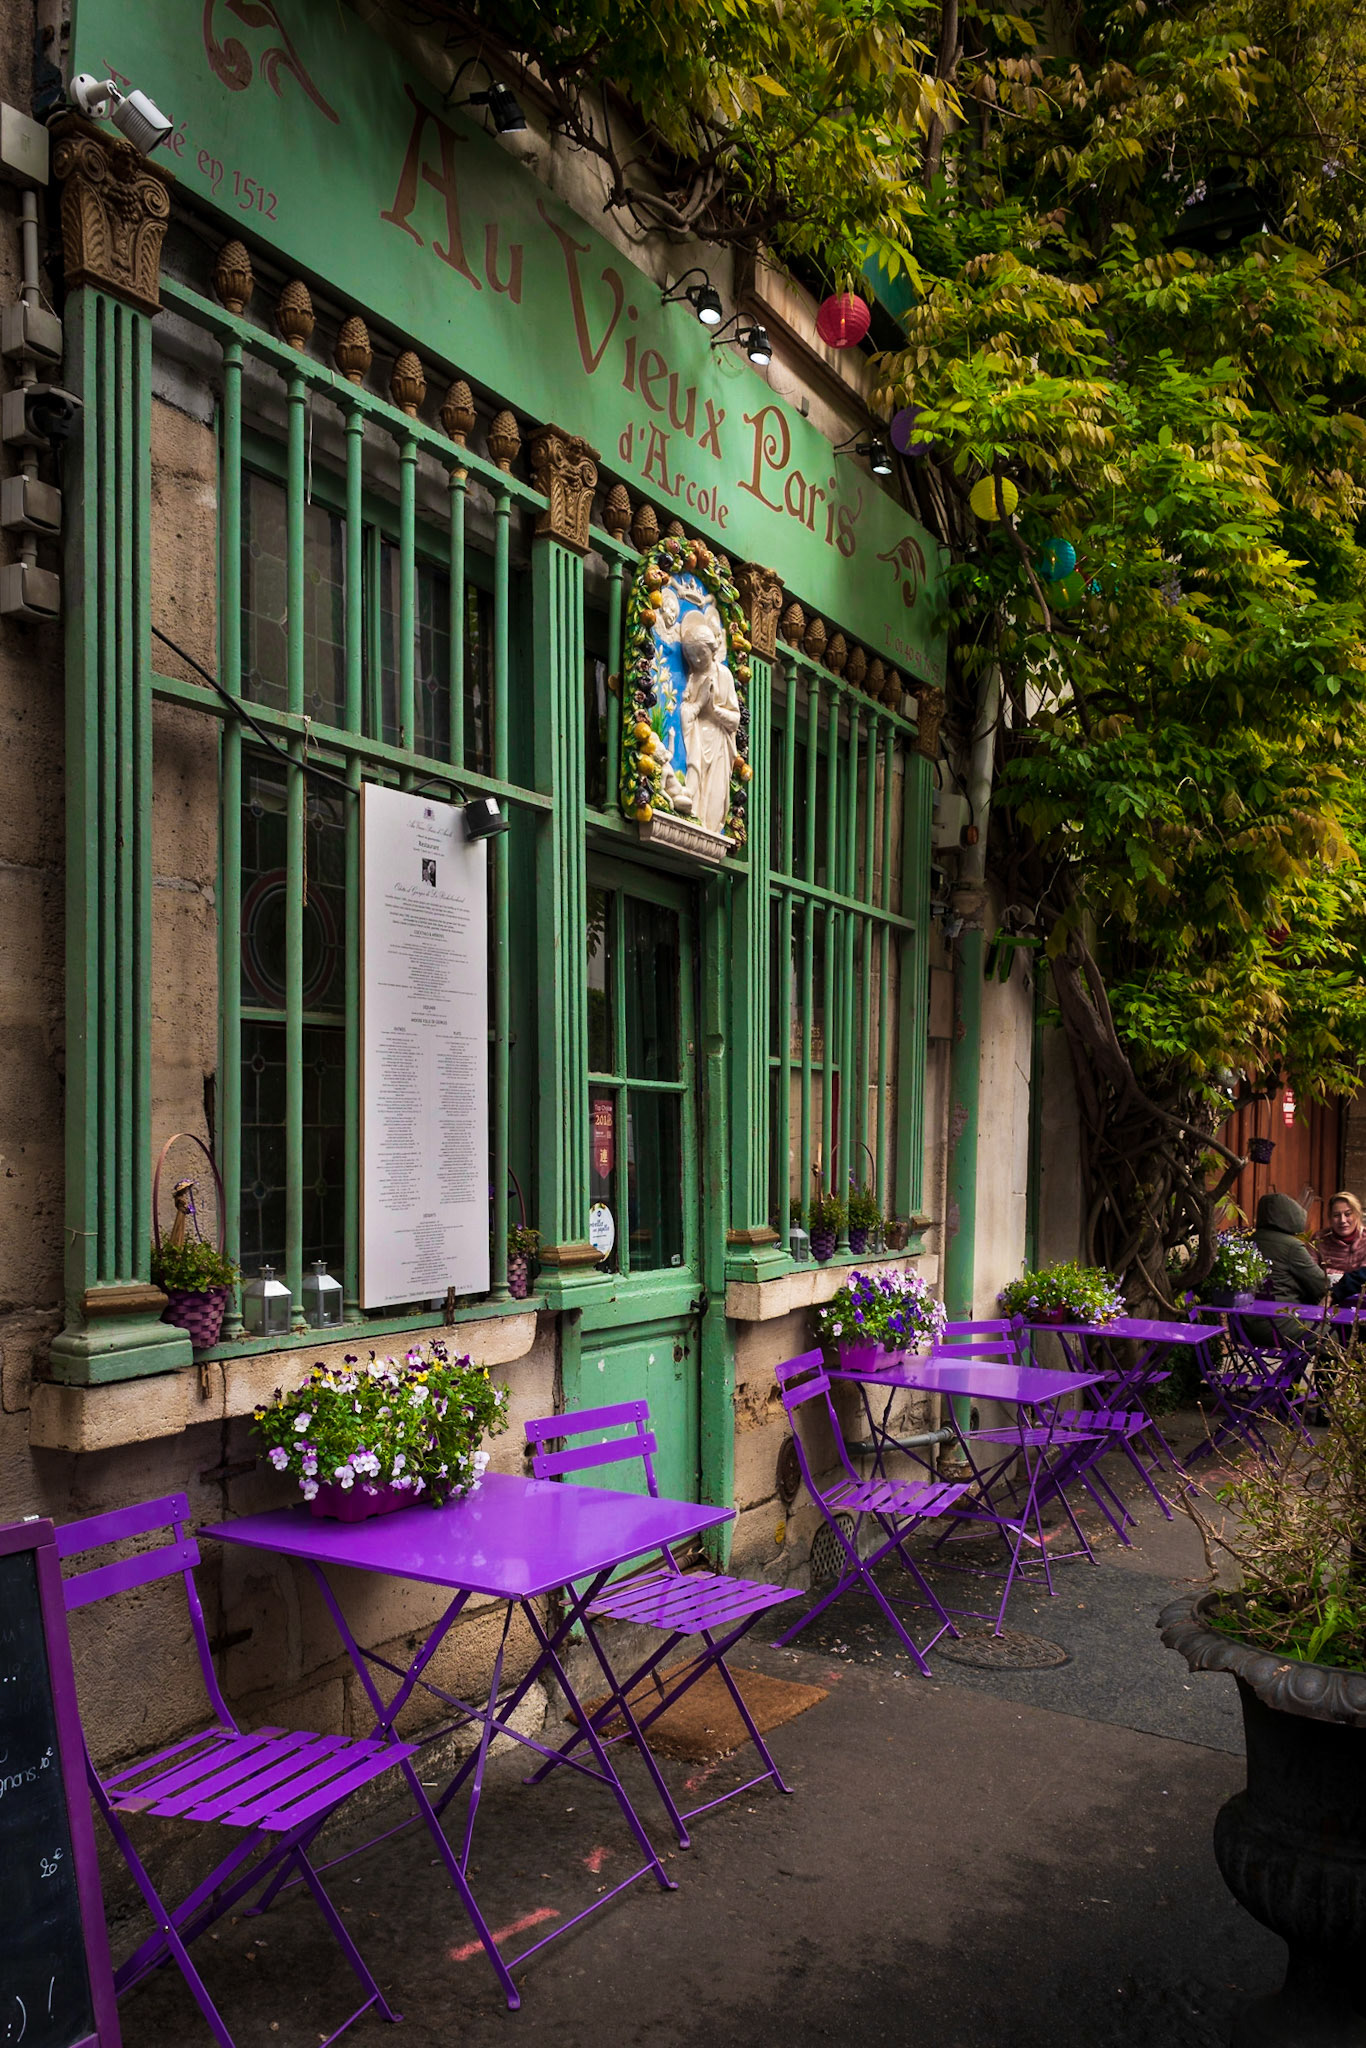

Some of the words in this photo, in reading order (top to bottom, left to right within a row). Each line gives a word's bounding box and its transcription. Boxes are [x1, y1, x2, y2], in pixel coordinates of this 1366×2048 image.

[197, 148, 224, 196] en
[232, 170, 278, 222] 1512
[380, 83, 523, 306] Au
[536, 197, 726, 460] Vieux
[737, 404, 863, 559] Paris
[618, 419, 730, 531] d'Arcole
